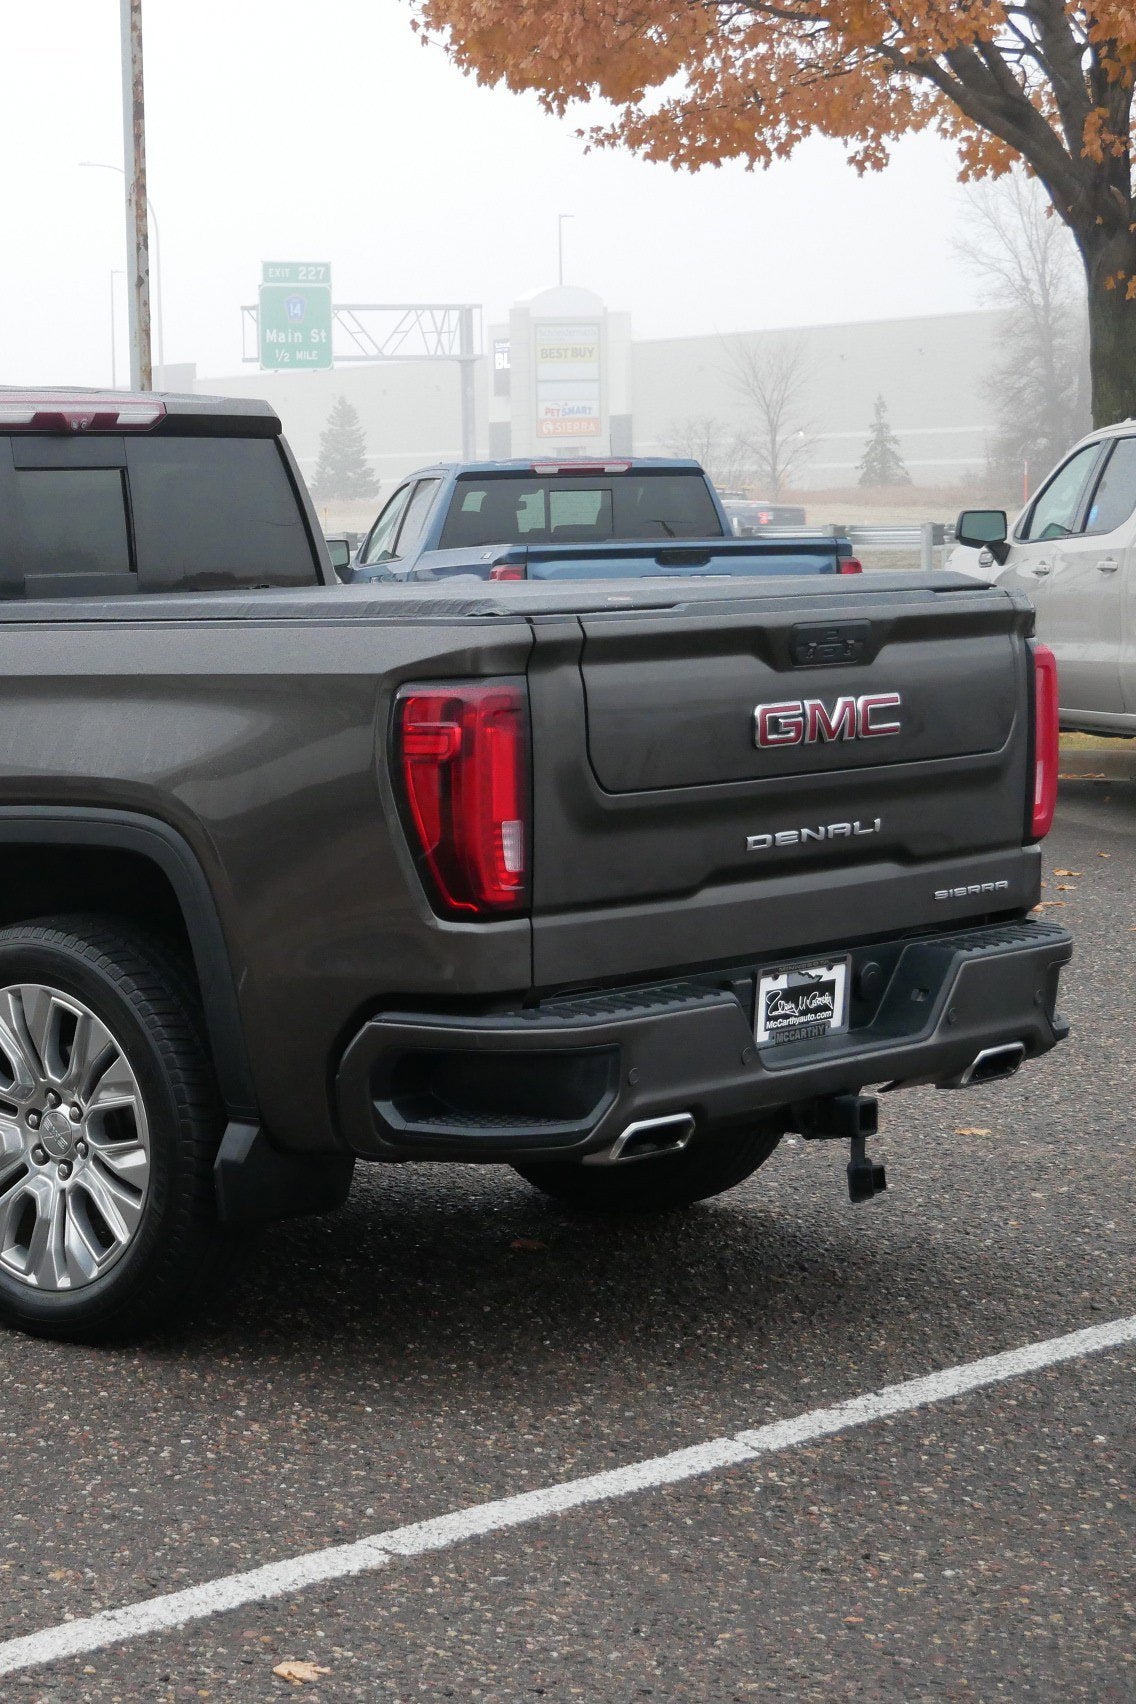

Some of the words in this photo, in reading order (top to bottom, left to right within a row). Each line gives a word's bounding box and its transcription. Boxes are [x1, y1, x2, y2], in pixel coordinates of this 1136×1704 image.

[268, 268, 291, 278] EXIT
[298, 266, 325, 280] 227
[289, 303, 301, 317] 14
[266, 328, 302, 343] Main
[310, 328, 327, 343] St
[296, 350, 318, 360] MILE
[540, 348, 569, 359] BEST
[570, 347, 596, 358] BUY
[555, 421, 596, 434] SIERRA
[754, 692, 901, 749] GMC
[746, 818, 881, 851] DENALI
[934, 880, 1008, 900] SIERRA
[765, 1010, 832, 1030] McCarthyauto.com
[774, 1023, 826, 1045] MCCARTHY
